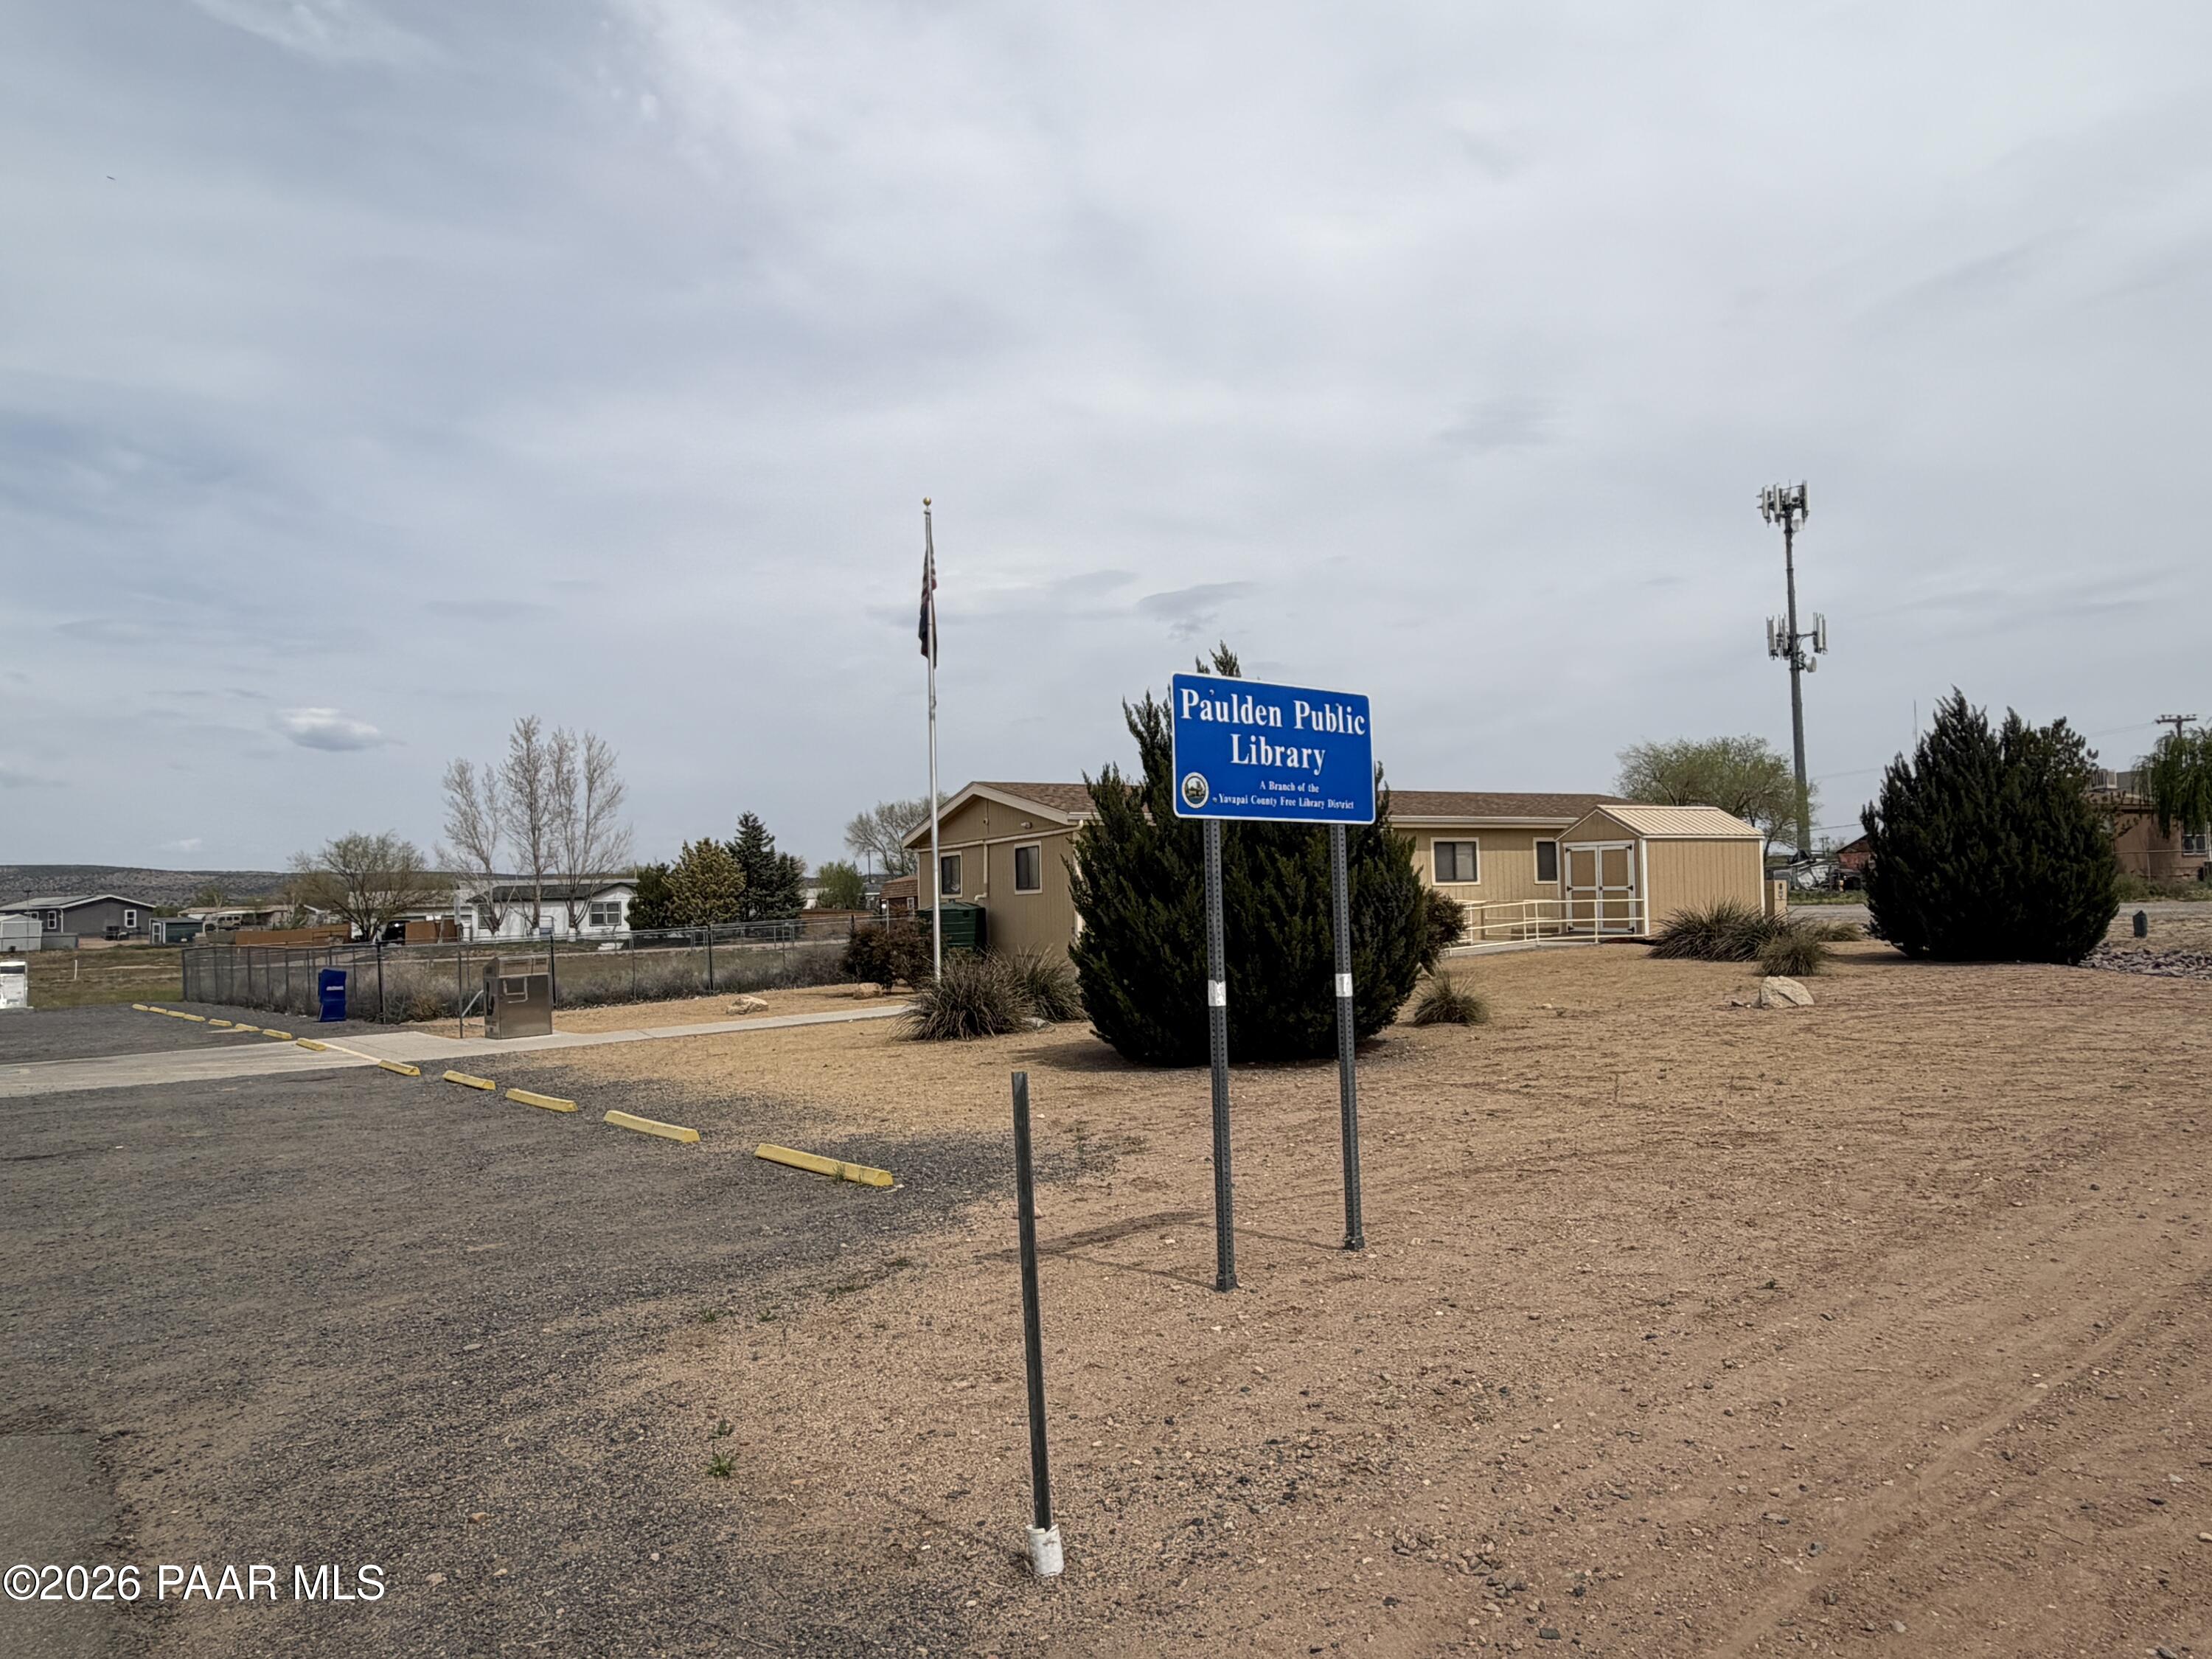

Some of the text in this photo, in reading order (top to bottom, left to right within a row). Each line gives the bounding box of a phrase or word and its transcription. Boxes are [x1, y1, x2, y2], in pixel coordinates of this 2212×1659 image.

[1180, 688, 1366, 735] Paulden Public
[1230, 734, 1326, 776] Library
[1219, 793, 1354, 809] Yavapai County Free Library District
[1259, 780, 1320, 793] A Branch of the
